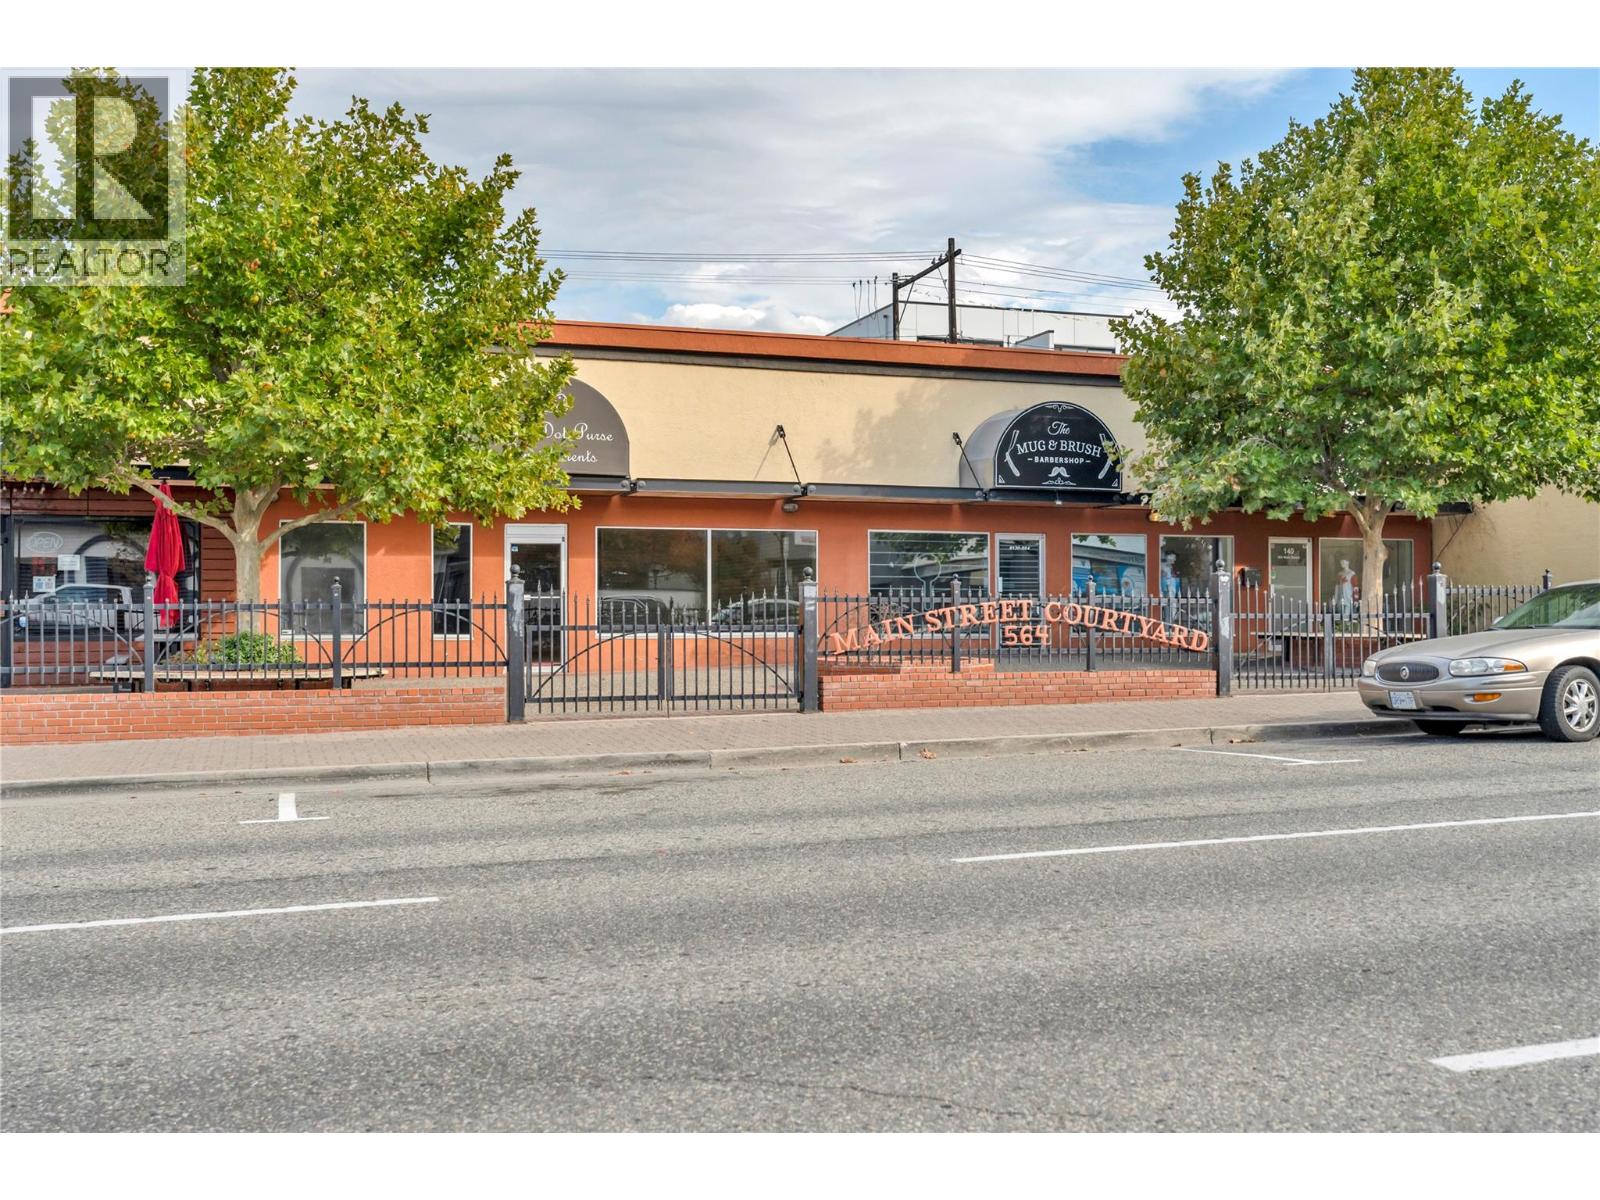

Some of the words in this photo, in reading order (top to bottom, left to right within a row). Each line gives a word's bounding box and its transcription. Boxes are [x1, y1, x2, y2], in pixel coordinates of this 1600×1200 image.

[543, 421, 567, 439] Dot
[574, 422, 614, 441] Purse
[1047, 421, 1071, 436] The
[1016, 440, 1046, 455] MUG
[1048, 441, 1058, 451] &
[1060, 439, 1103, 458] BRUSH
[1034, 456, 1085, 464] BARBERSHOP
[829, 614, 915, 655] MAIN
[924, 600, 1033, 633] STREET
[1045, 601, 1209, 652] COURTYARD
[1004, 624, 1049, 646] 564
